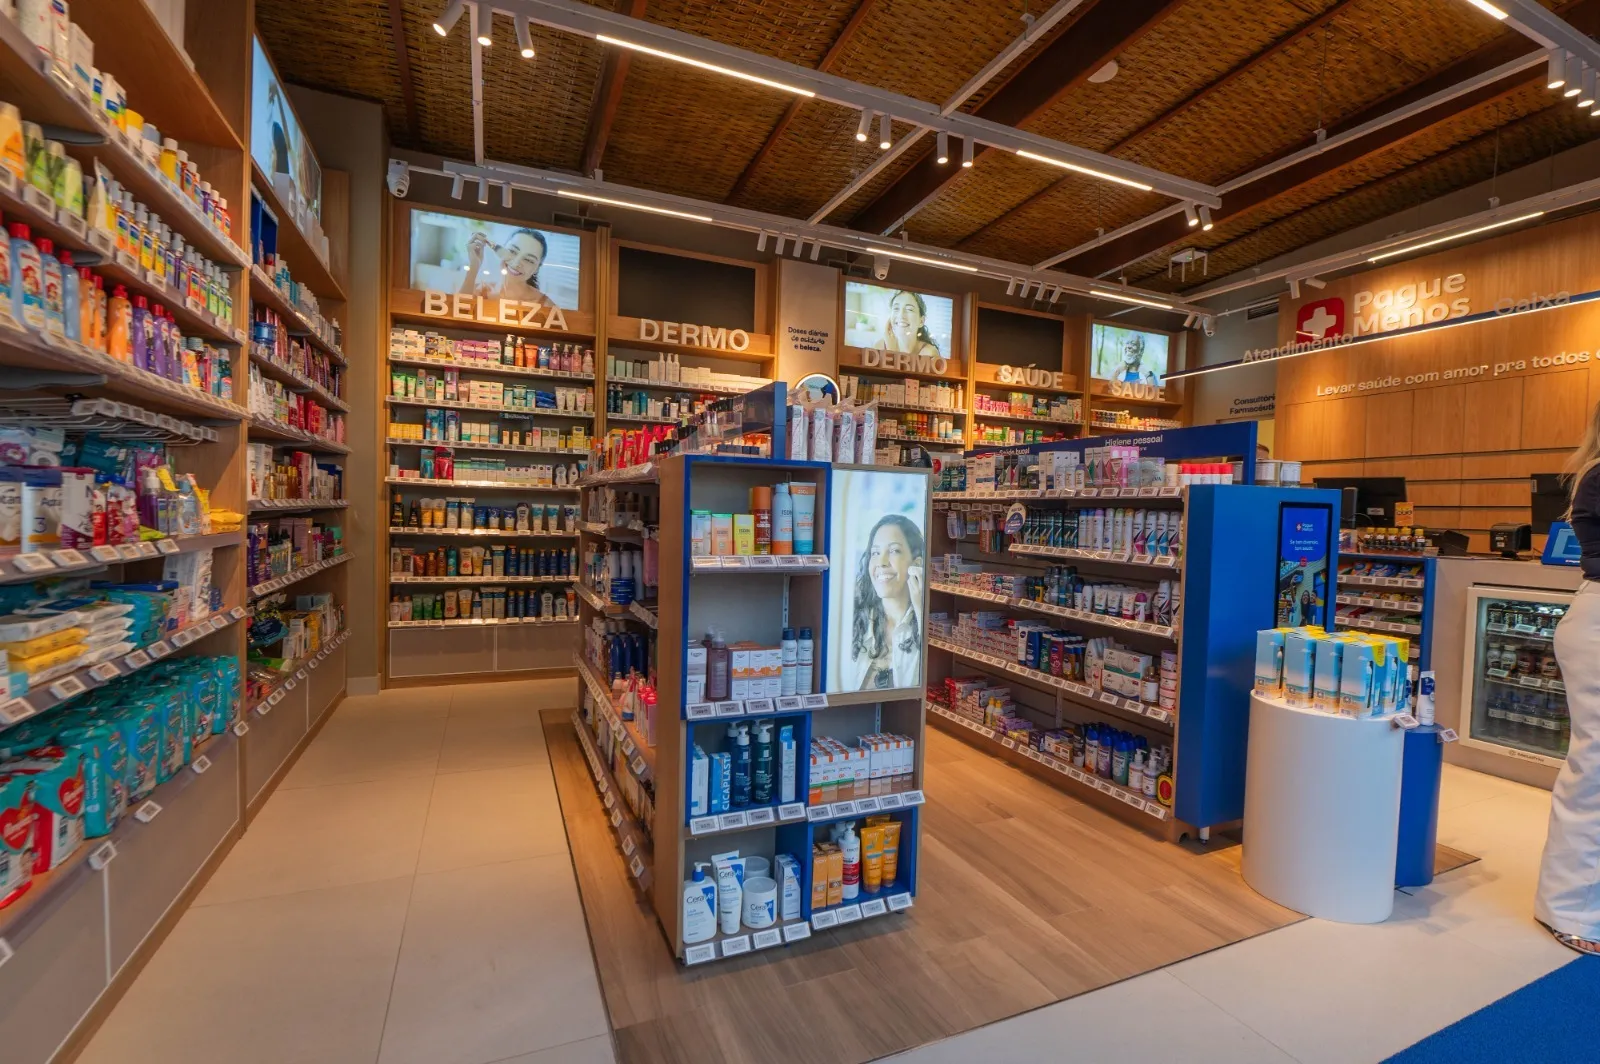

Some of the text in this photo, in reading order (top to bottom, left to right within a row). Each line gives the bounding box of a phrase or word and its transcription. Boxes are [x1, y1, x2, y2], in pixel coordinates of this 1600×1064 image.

[1353, 273, 1466, 313] Pague
[1494, 291, 1571, 315] Caixa
[424, 289, 569, 331] BELEZA
[1353, 297, 1471, 337] Menos
[639, 318, 750, 352] DERMO
[1242, 332, 1354, 363] Atendimento
[862, 347, 948, 375] DERMO
[1317, 382, 1355, 396] Levar
[1358, 375, 1401, 391] saúde
[1404, 371, 1440, 385] com
[1443, 365, 1489, 380] amor
[1493, 360, 1527, 376] pra
[1531, 351, 1591, 369] todos
[999, 363, 1064, 390] SAÚDE
[1229, 402, 1275, 415] Farmacêuti
[1233, 393, 1275, 406] Consultóri
[1105, 434, 1163, 447] Higiene pessoal
[33, 517, 47, 533] 3
[722, 754, 731, 811] CICAPLAST
[686, 892, 714, 904] CeraVe
[750, 901, 773, 911] CeraVe
